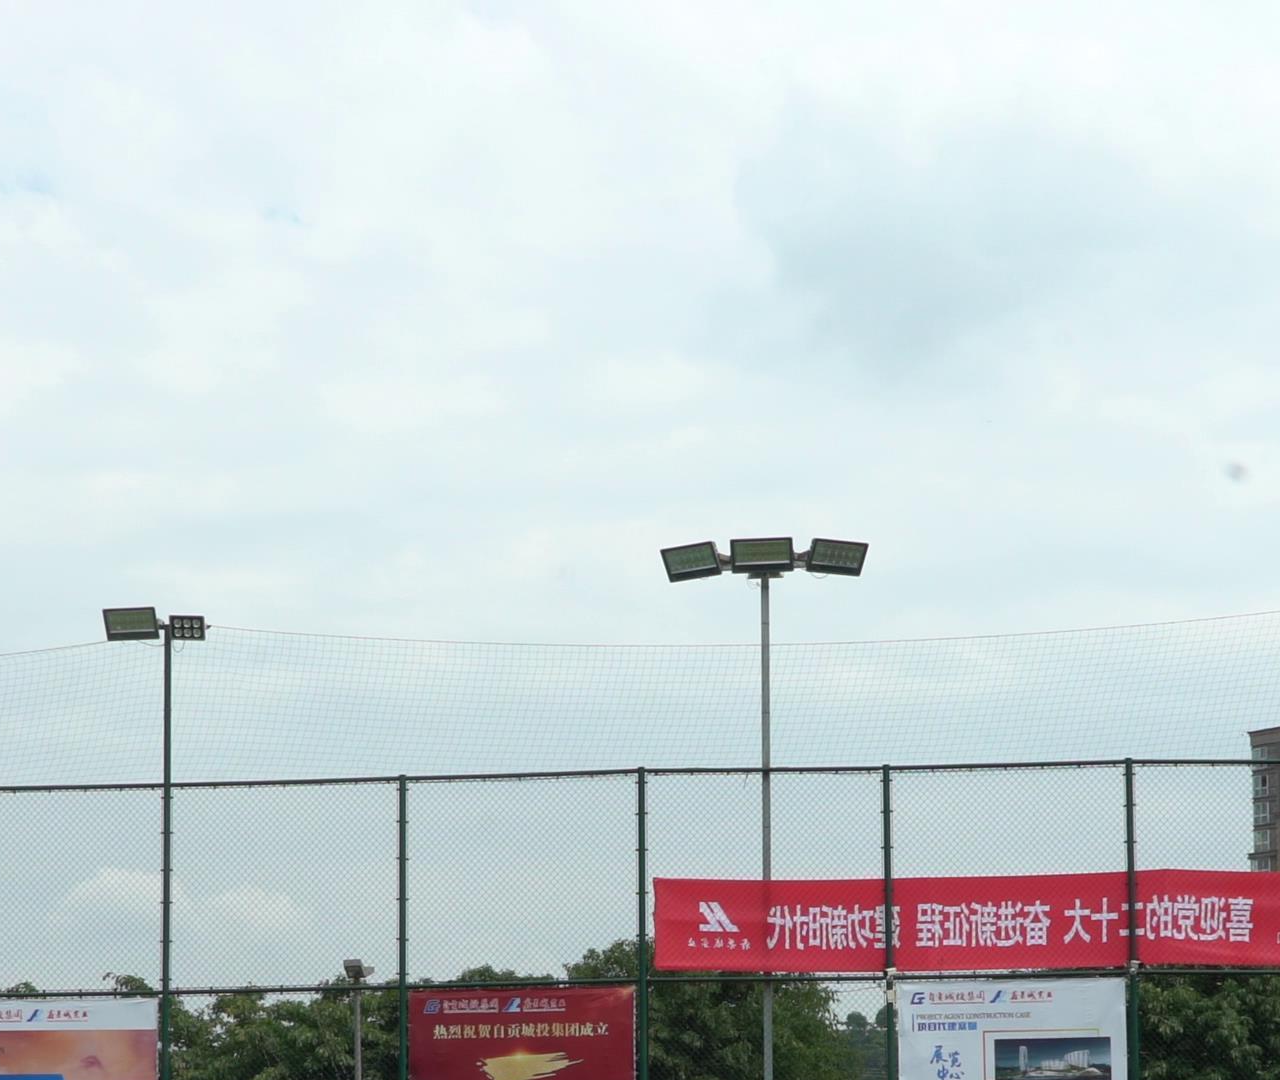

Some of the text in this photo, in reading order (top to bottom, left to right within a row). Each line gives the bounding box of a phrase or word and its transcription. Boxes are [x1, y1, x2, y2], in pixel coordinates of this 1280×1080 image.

[432, 1021, 609, 1040] 热烈祝贺自贡城投集团成立
